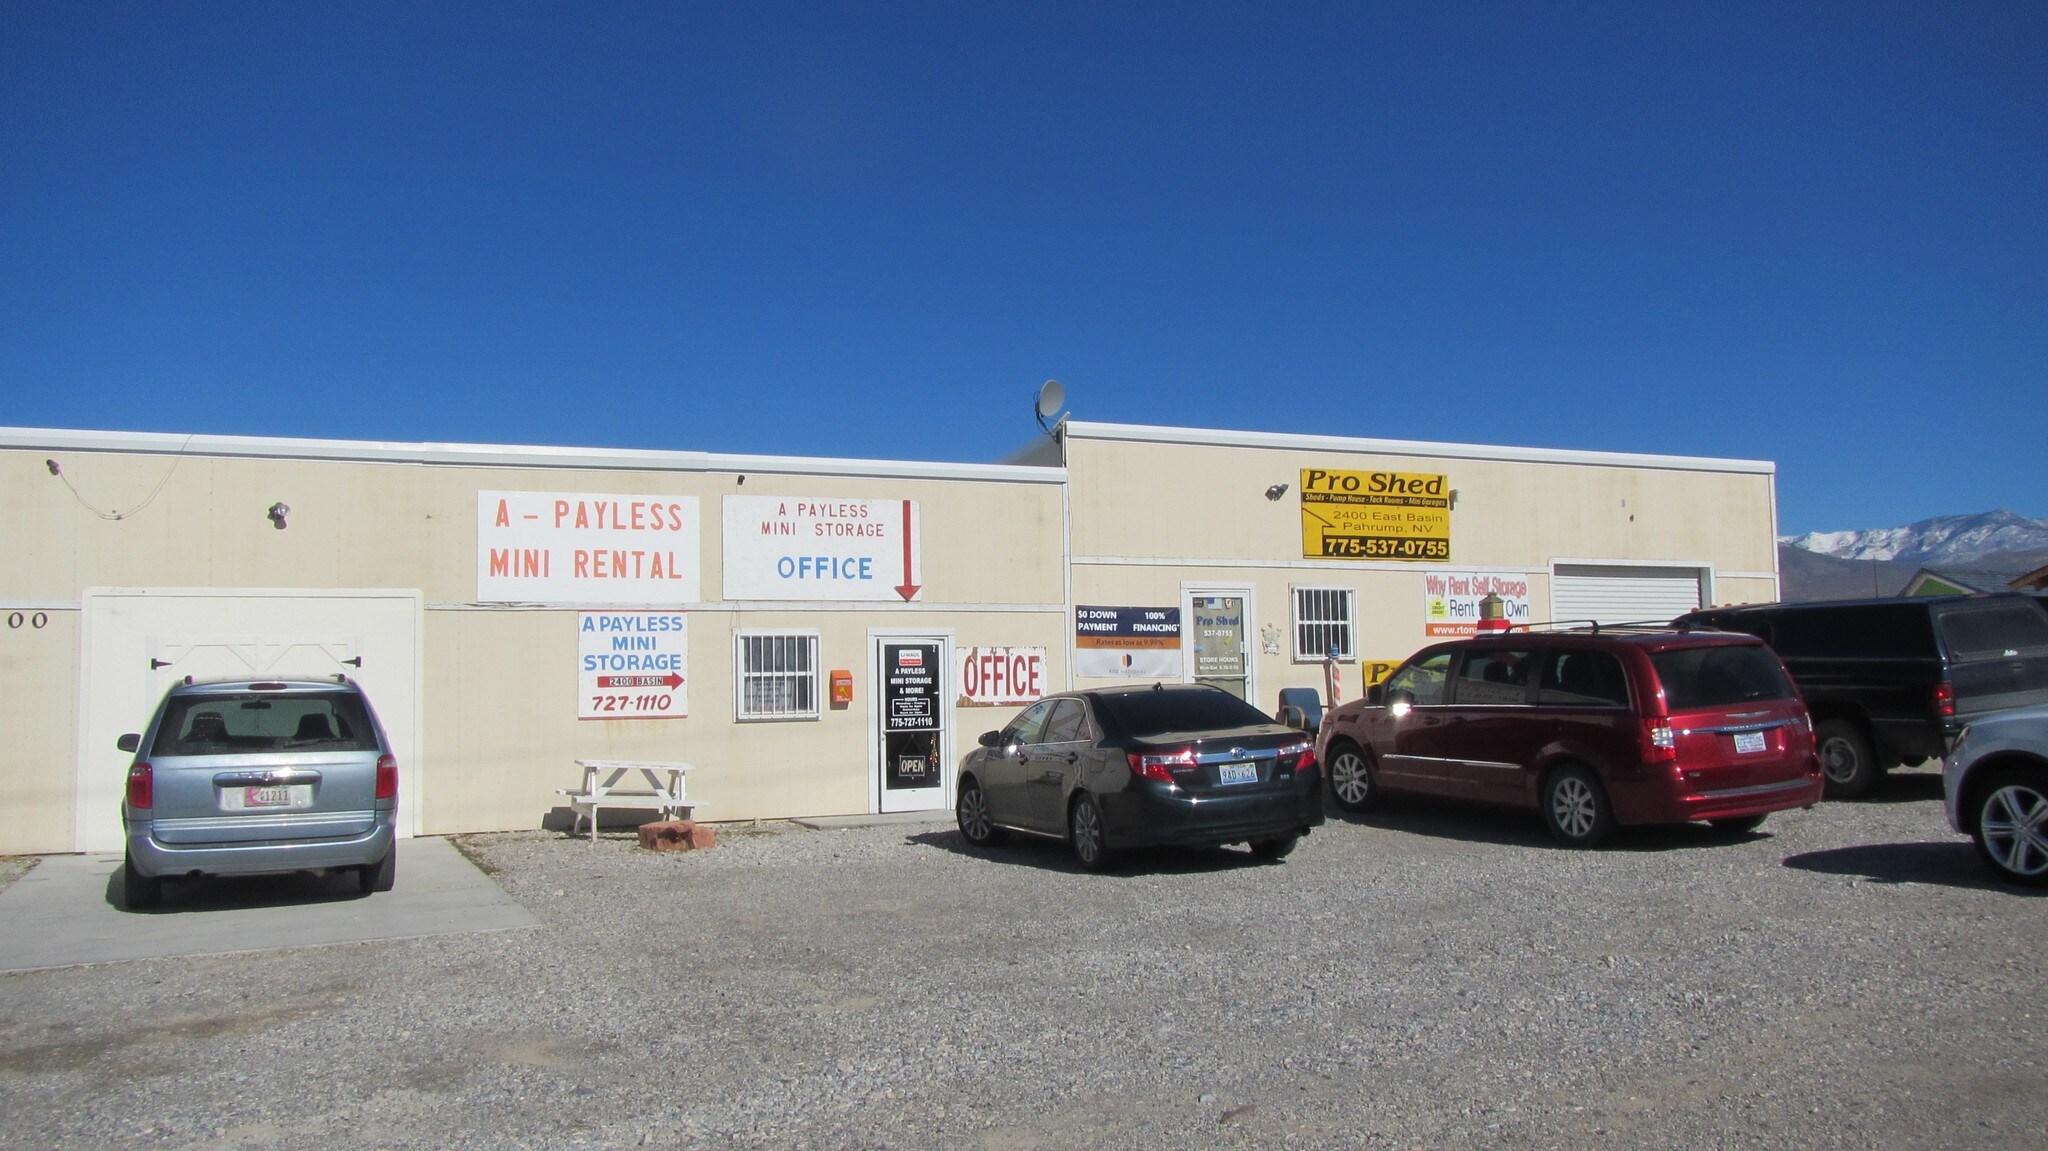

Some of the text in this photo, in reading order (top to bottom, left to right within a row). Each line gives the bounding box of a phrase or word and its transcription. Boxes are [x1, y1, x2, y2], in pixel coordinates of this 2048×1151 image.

[1305, 470, 1443, 495] Pro Shed
[1305, 493, 1325, 501] Sheds
[1329, 494, 1347, 503] Pump
[1348, 495, 1365, 503] House
[1384, 496, 1404, 504] Rooms
[1408, 497, 1421, 505] Mini
[1422, 498, 1446, 508] Garages
[495, 499, 510, 528] A
[554, 501, 683, 531] PAYLESS
[778, 503, 868, 518] A PAYLESS
[1333, 510, 1443, 522] 2400 East Basin
[761, 522, 885, 538] MINI STORAGE
[1342, 522, 1433, 534] Pahrump, NV
[1325, 538, 1448, 556] 775-537-0755
[489, 549, 683, 580] MINI RENTAL
[777, 557, 873, 580] OFFICE
[1425, 575, 1527, 599] Why Rent Self Storage
[1077, 610, 1166, 620] $0 DOWN 100%
[1450, 599, 1529, 617] Rent Own
[582, 616, 683, 632] A PAYLESS
[1078, 623, 1118, 632] PAYMENT
[1196, 615, 1239, 626] Pro Shed
[1204, 629, 1233, 637] 537-0755
[612, 636, 657, 651] MINI
[583, 654, 681, 671] STORAGE
[895, 667, 926, 675] A PAYLESS
[963, 655, 1041, 697] OFFICE
[610, 677, 664, 686] 2400 BASIN
[890, 677, 932, 685] MINI STORAGE
[899, 687, 924, 695] & MORE!
[592, 694, 672, 711] 727-1110
[890, 717, 933, 727] 775-727-1110
[901, 759, 924, 773] OPEN
